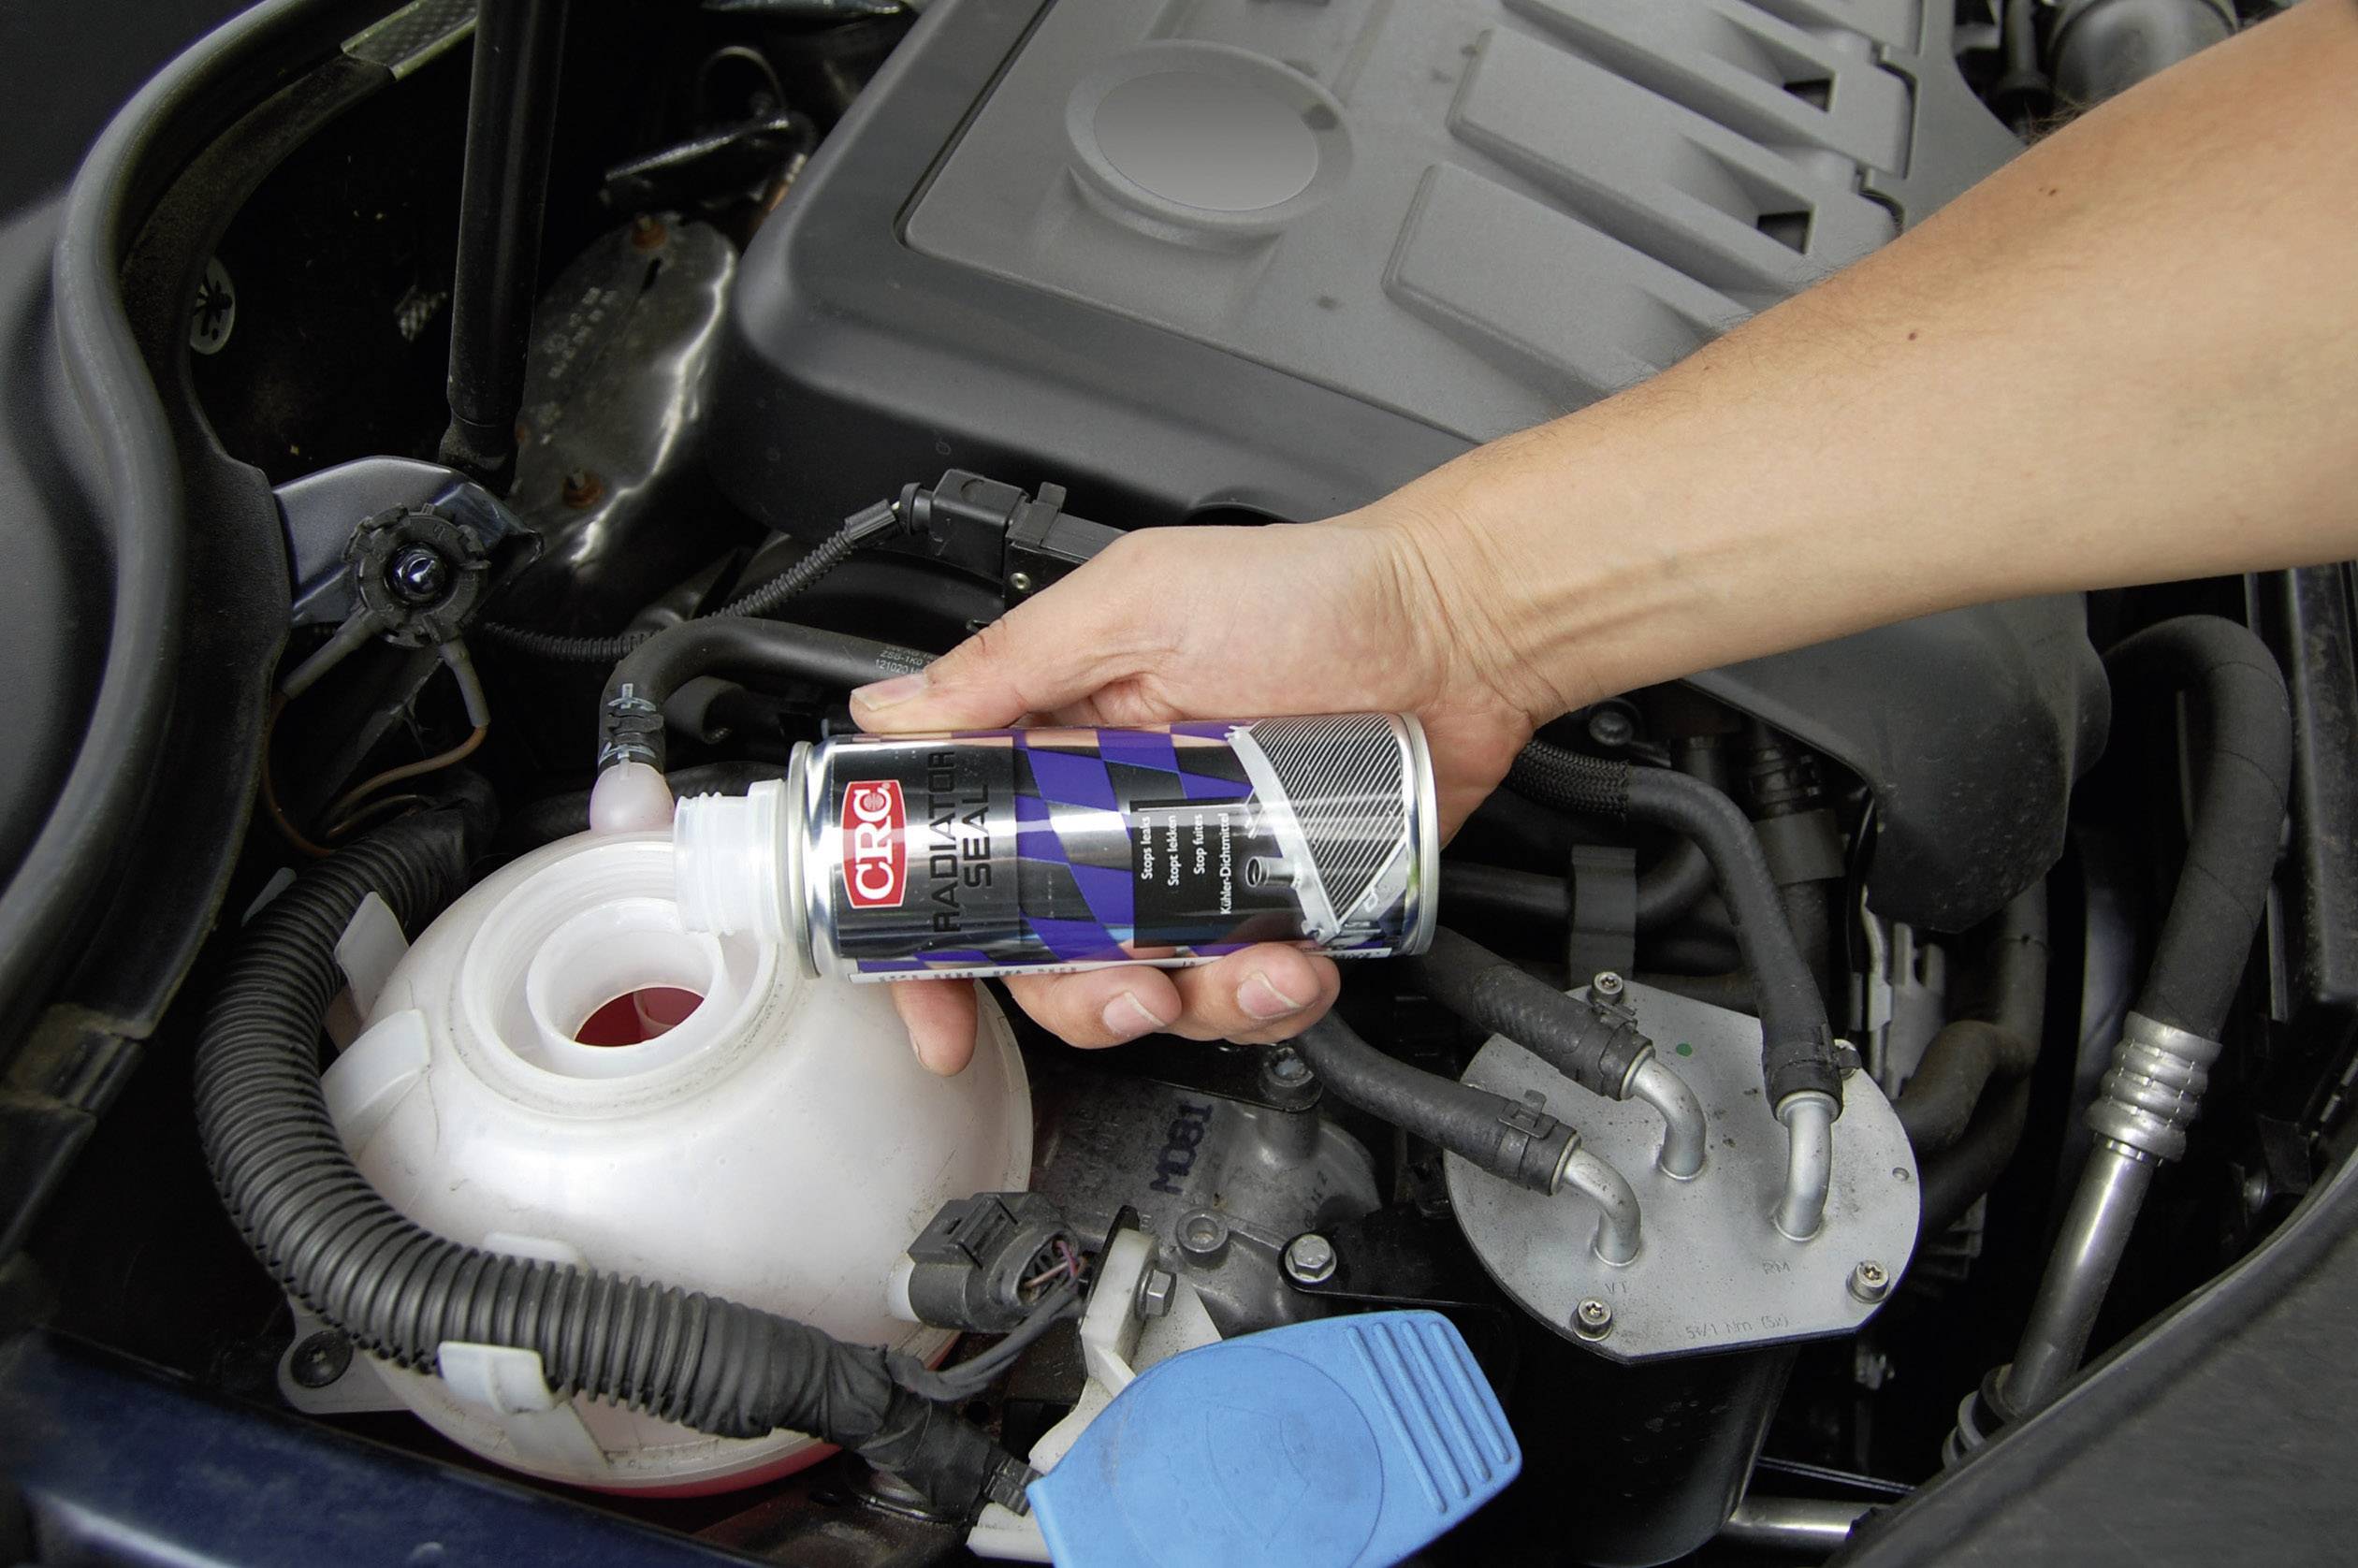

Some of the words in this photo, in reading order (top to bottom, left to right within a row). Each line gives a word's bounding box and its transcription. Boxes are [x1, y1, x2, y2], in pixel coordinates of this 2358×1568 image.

[853, 784, 895, 900] CRC
[929, 751, 961, 932] RADIATOR
[962, 784, 992, 887] SEAL
[1140, 816, 1152, 845] leaks
[1166, 815, 1178, 852] lekken
[1192, 814, 1204, 845] fuites
[1141, 847, 1155, 879] Stops
[1168, 854, 1182, 886] Stopt
[1193, 848, 1207, 875] Stop
[1218, 812, 1231, 915] Kühler-Dichtmittel
